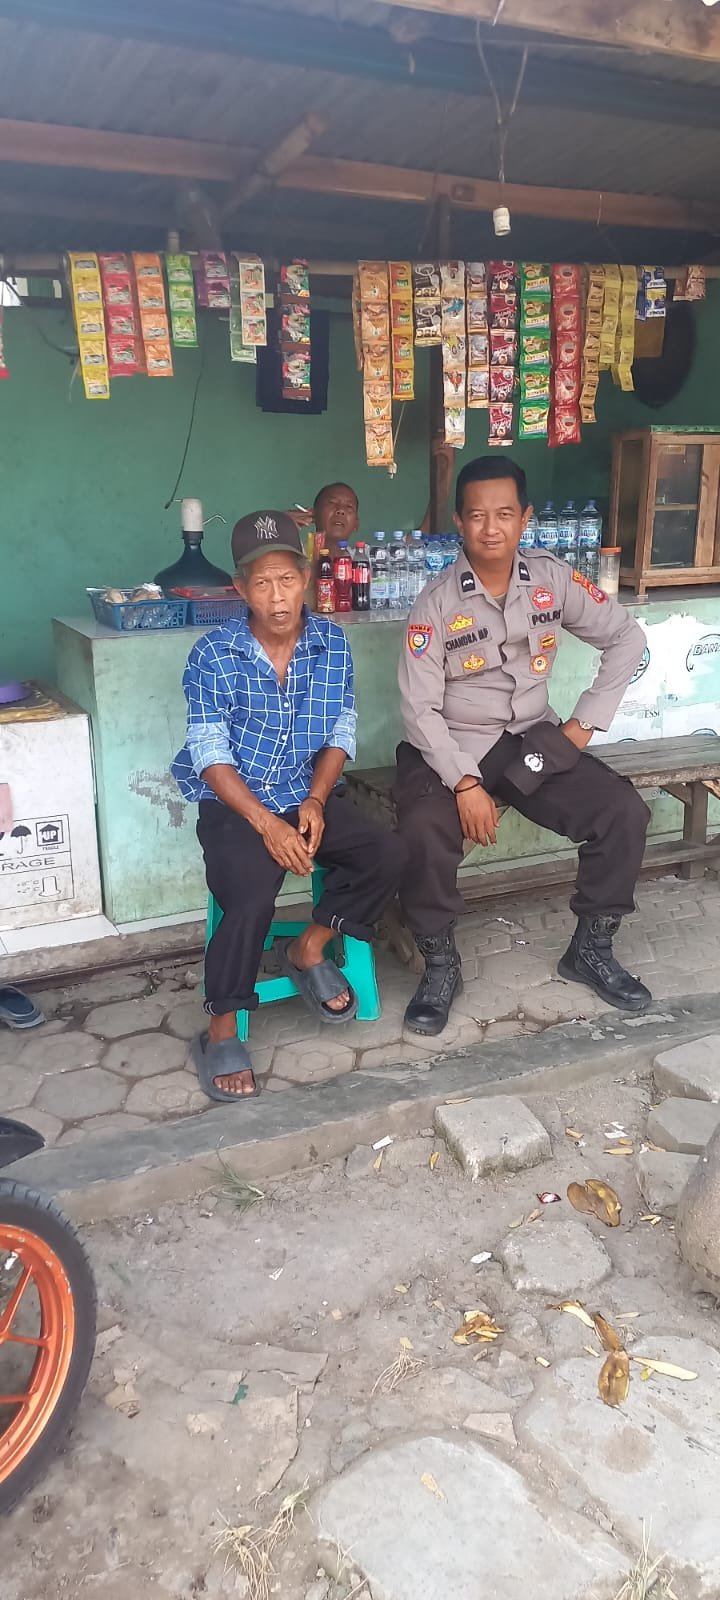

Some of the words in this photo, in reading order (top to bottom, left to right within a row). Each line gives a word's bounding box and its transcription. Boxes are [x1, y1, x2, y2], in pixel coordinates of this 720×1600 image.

[532, 609, 562, 626] POLRI
[445, 633, 478, 651] CHANDRA
[42, 830, 57, 841] UP
[2, 857, 55, 871] RAGE
